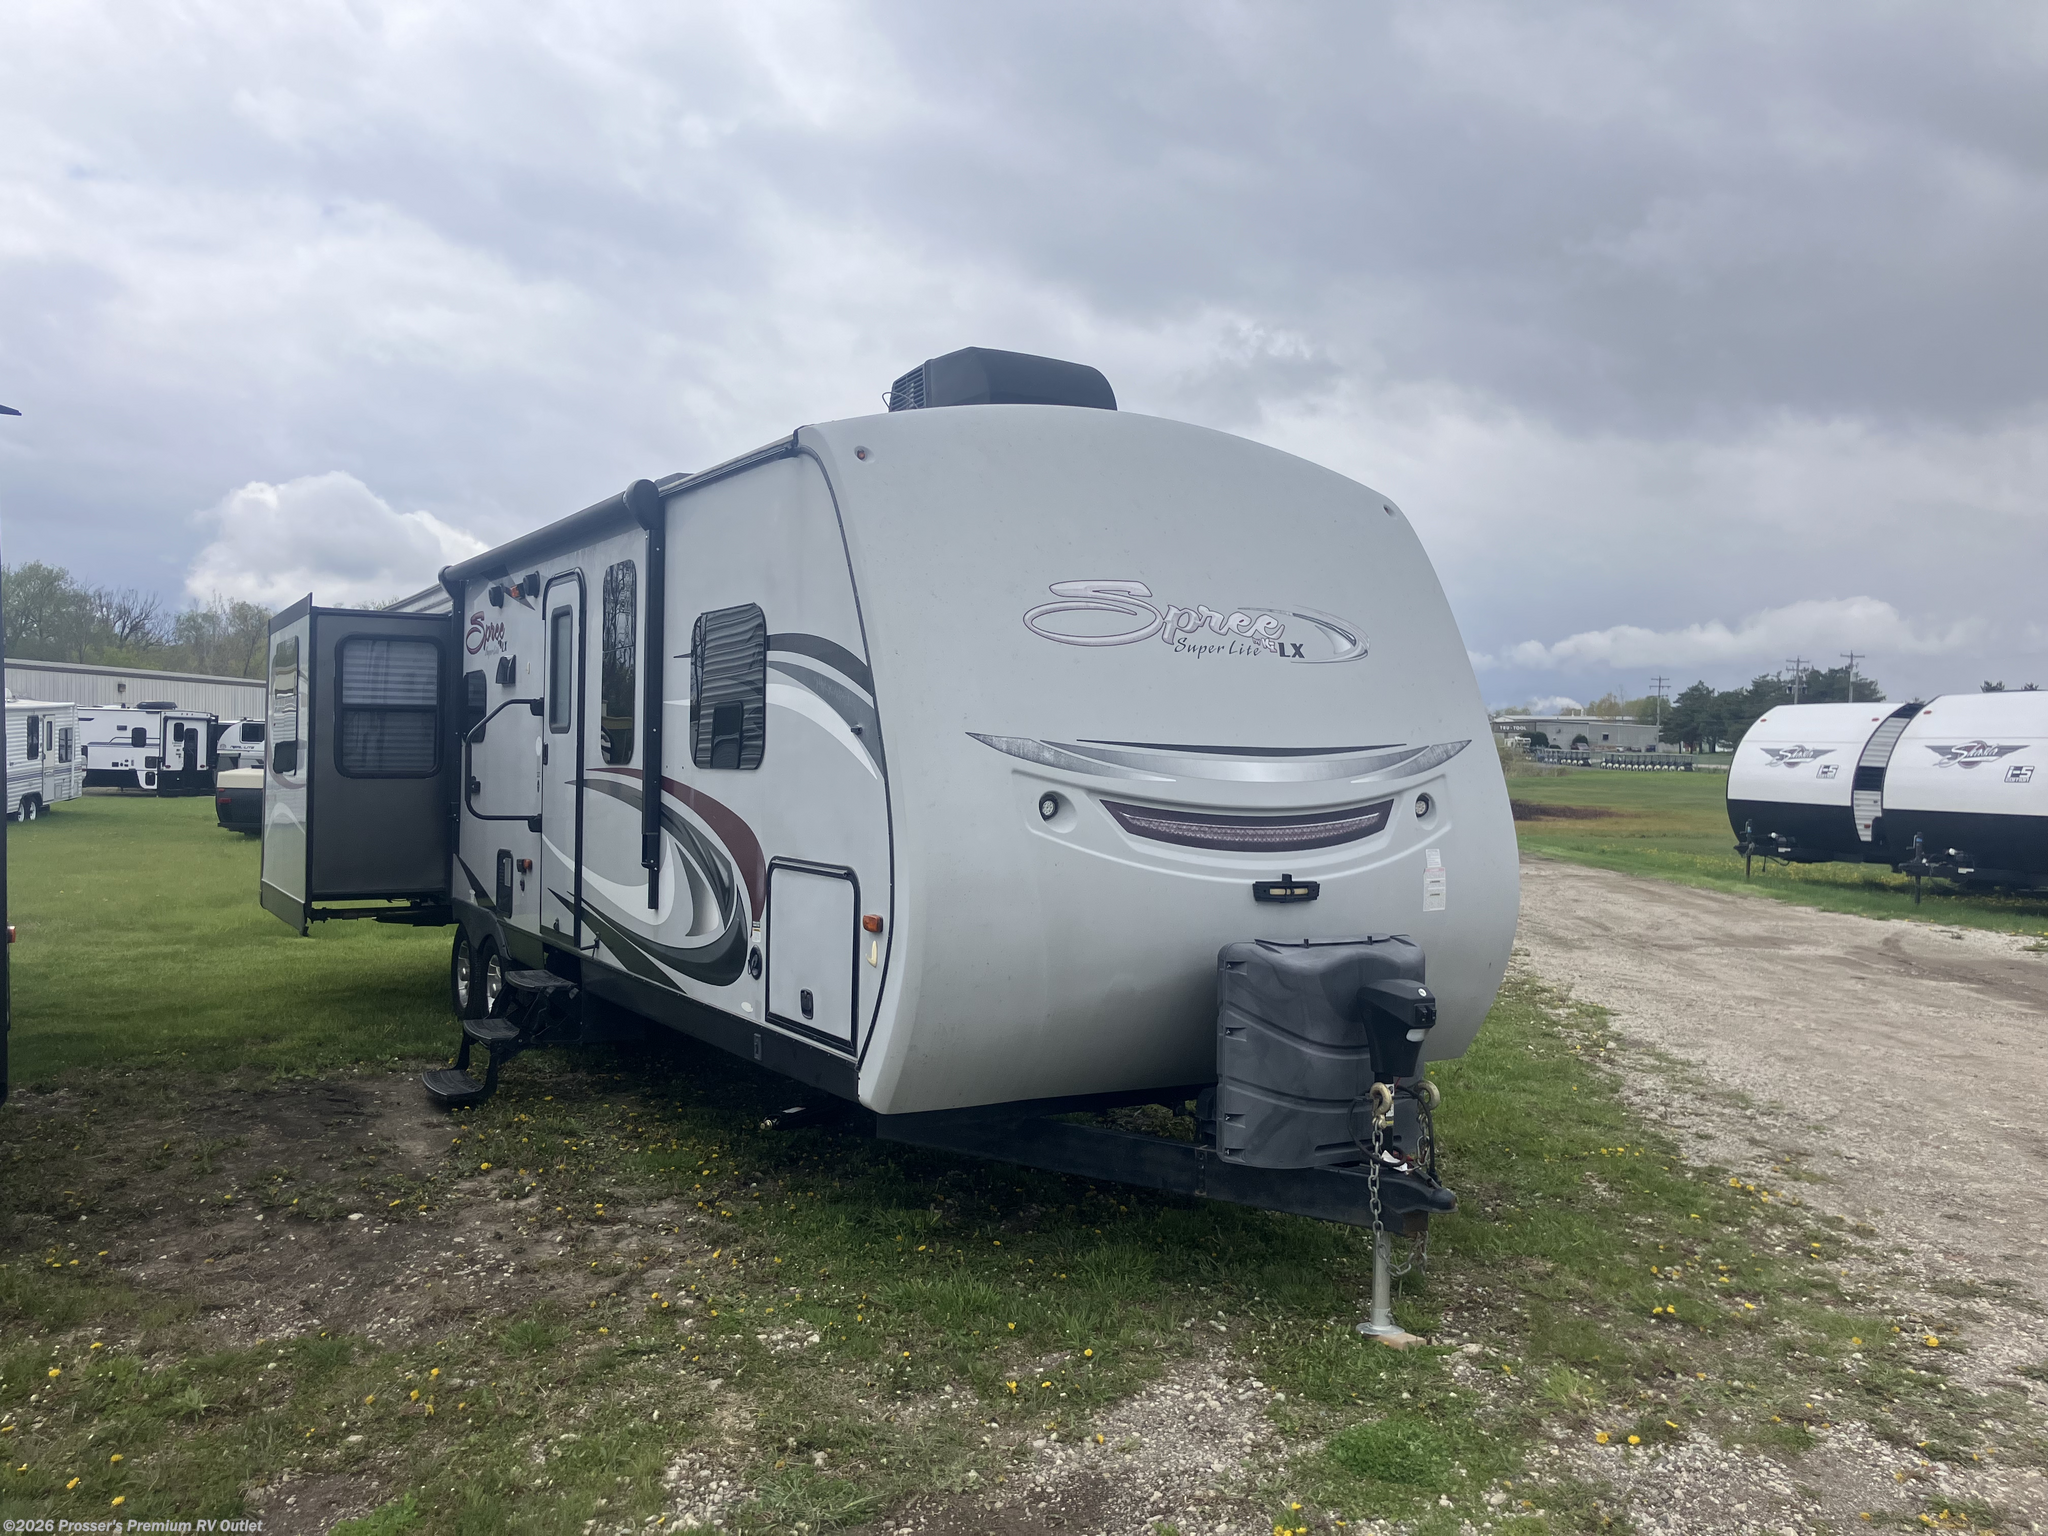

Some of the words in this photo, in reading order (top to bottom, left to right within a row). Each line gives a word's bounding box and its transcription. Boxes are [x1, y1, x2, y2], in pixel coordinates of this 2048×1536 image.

[1023, 580, 1285, 646] Spree
[466, 611, 505, 654] Spree
[1174, 637, 1225, 659] Super
[1229, 639, 1261, 656] Lite
[1278, 642, 1305, 659] LX
